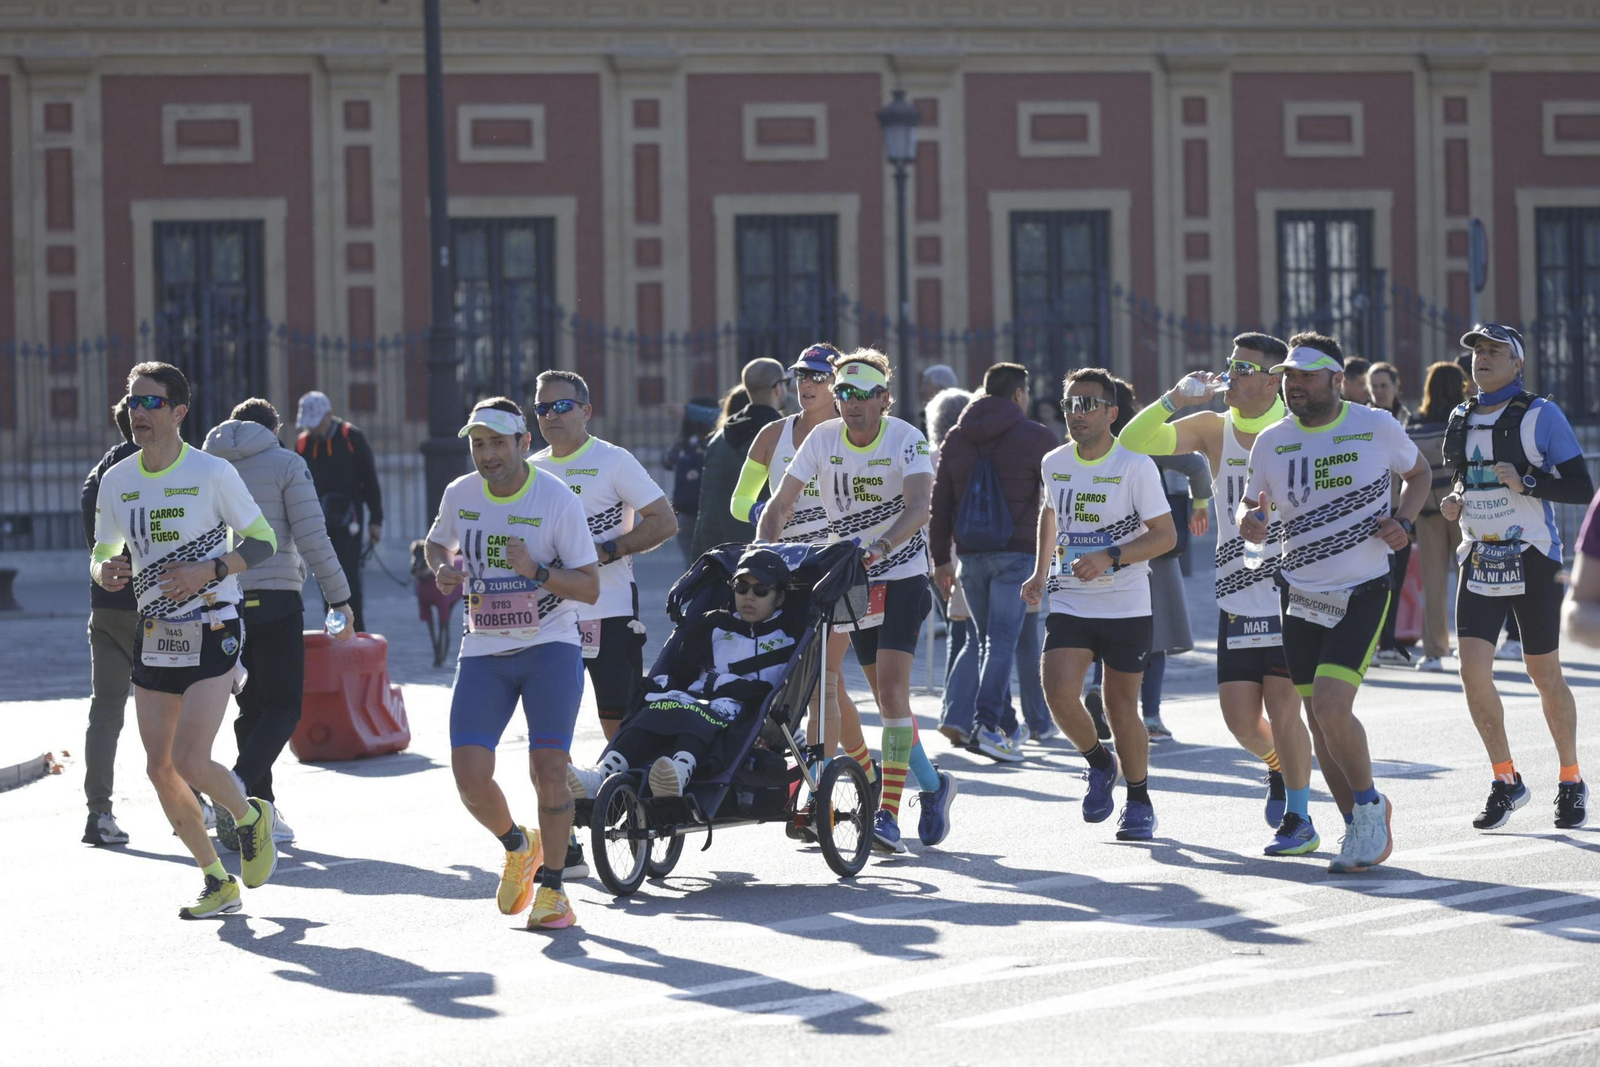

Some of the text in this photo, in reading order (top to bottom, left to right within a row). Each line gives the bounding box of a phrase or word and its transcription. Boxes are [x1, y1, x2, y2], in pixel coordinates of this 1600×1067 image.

[1314, 452, 1359, 468] CARROS
[1314, 468, 1329, 480] DE
[852, 476, 884, 486] CARROS
[1315, 475, 1353, 491] FUEGO
[853, 484, 865, 493] DE
[854, 493, 882, 502] FUEGO
[1076, 492, 1107, 503] CARROS
[1074, 502, 1085, 512] DE
[149, 507, 185, 520] CARROS
[1074, 512, 1100, 523] FUEGO
[1494, 508, 1516, 519] MAYOR
[150, 521, 162, 532] DE
[151, 531, 180, 543] FUEGO
[1073, 536, 1104, 544] ZURICH
[487, 547, 500, 558] DE
[1487, 571, 1499, 583] NI
[1501, 570, 1521, 583] NA!
[488, 580, 527, 591] ZURICH
[491, 600, 512, 610] 8783
[474, 611, 533, 627] ROBERTO
[1243, 620, 1269, 634] MAR
[157, 638, 190, 652] DIEGO
